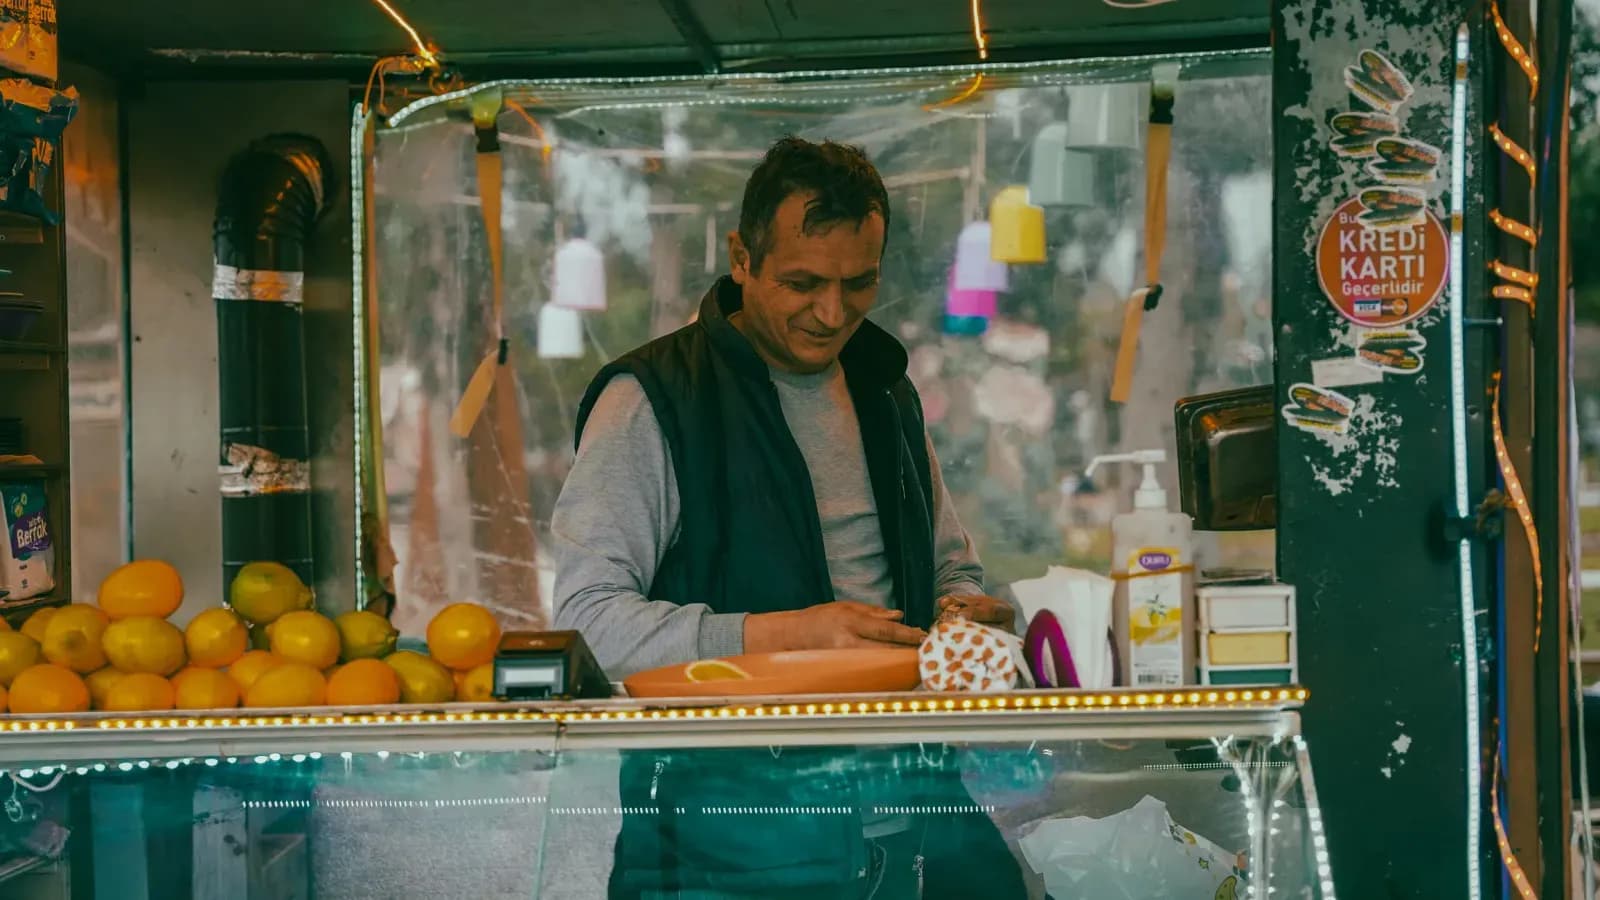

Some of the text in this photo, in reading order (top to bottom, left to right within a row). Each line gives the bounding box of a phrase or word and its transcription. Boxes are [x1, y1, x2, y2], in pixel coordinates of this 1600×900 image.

[1341, 255, 1425, 280] KARTI
[1342, 279, 1425, 297] Geçerlidir
[17, 521, 48, 549] Berrak
